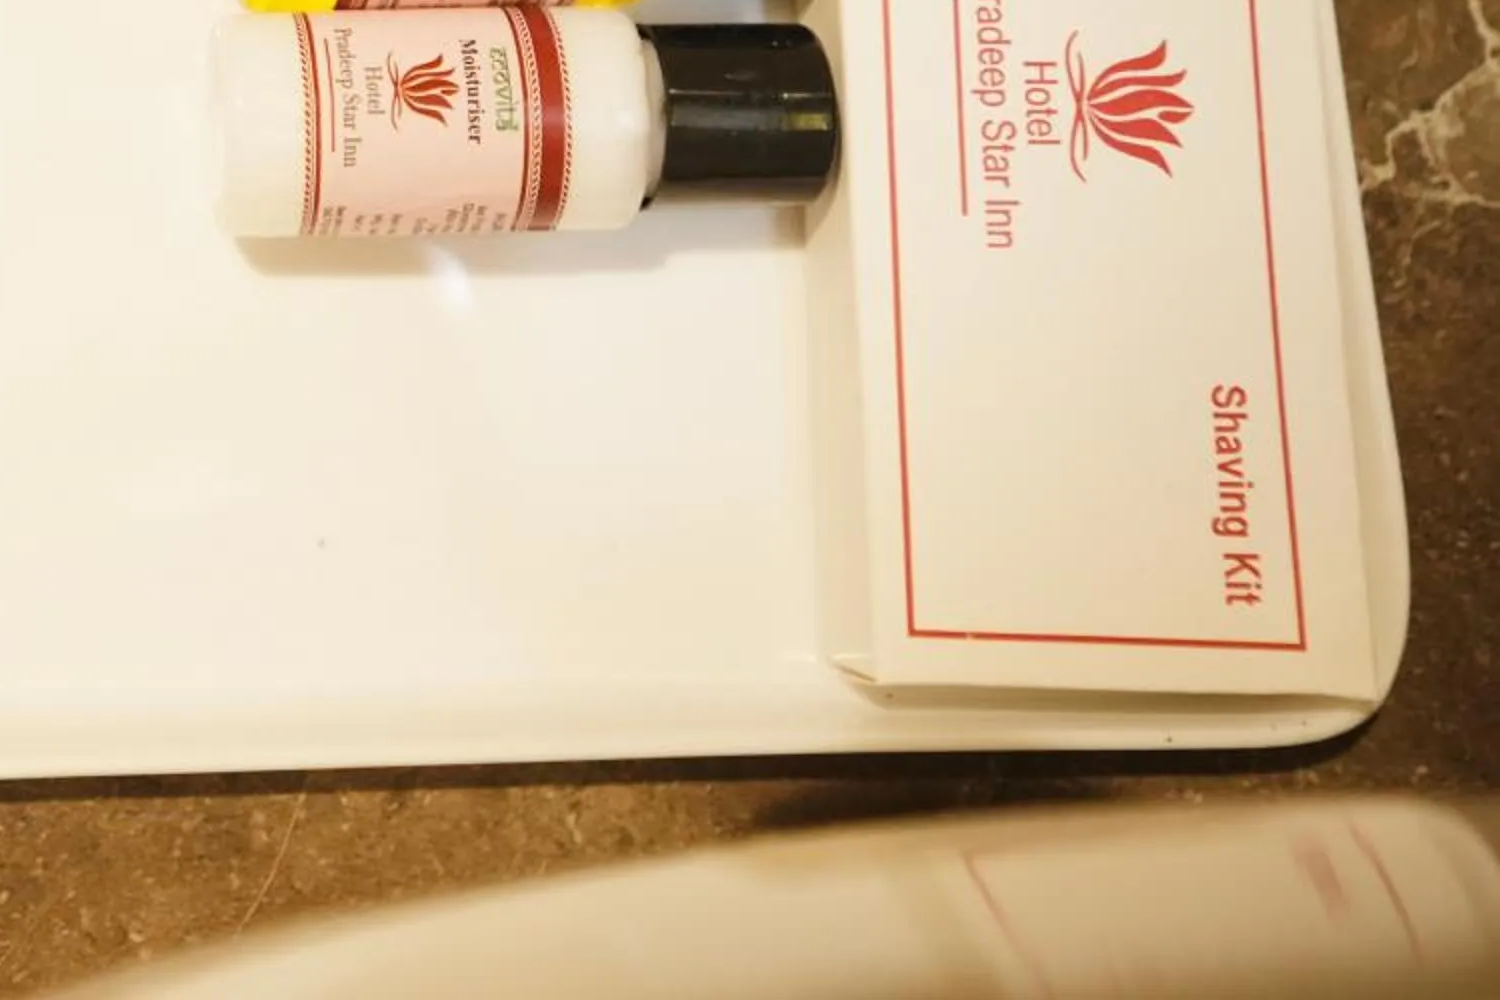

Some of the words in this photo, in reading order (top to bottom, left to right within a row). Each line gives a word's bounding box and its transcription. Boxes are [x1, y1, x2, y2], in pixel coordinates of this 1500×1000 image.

[333, 28, 355, 88] Pradeep
[342, 93, 360, 130] Star
[364, 66, 385, 115] Hotel
[459, 39, 485, 145] Moisturiser
[1023, 61, 1061, 145] Hotel
[342, 137, 361, 168] Inn
[981, 119, 1018, 188] Star
[984, 200, 1021, 249] Inn
[1212, 385, 1255, 538] Shaving
[1222, 553, 1262, 606] Kit
